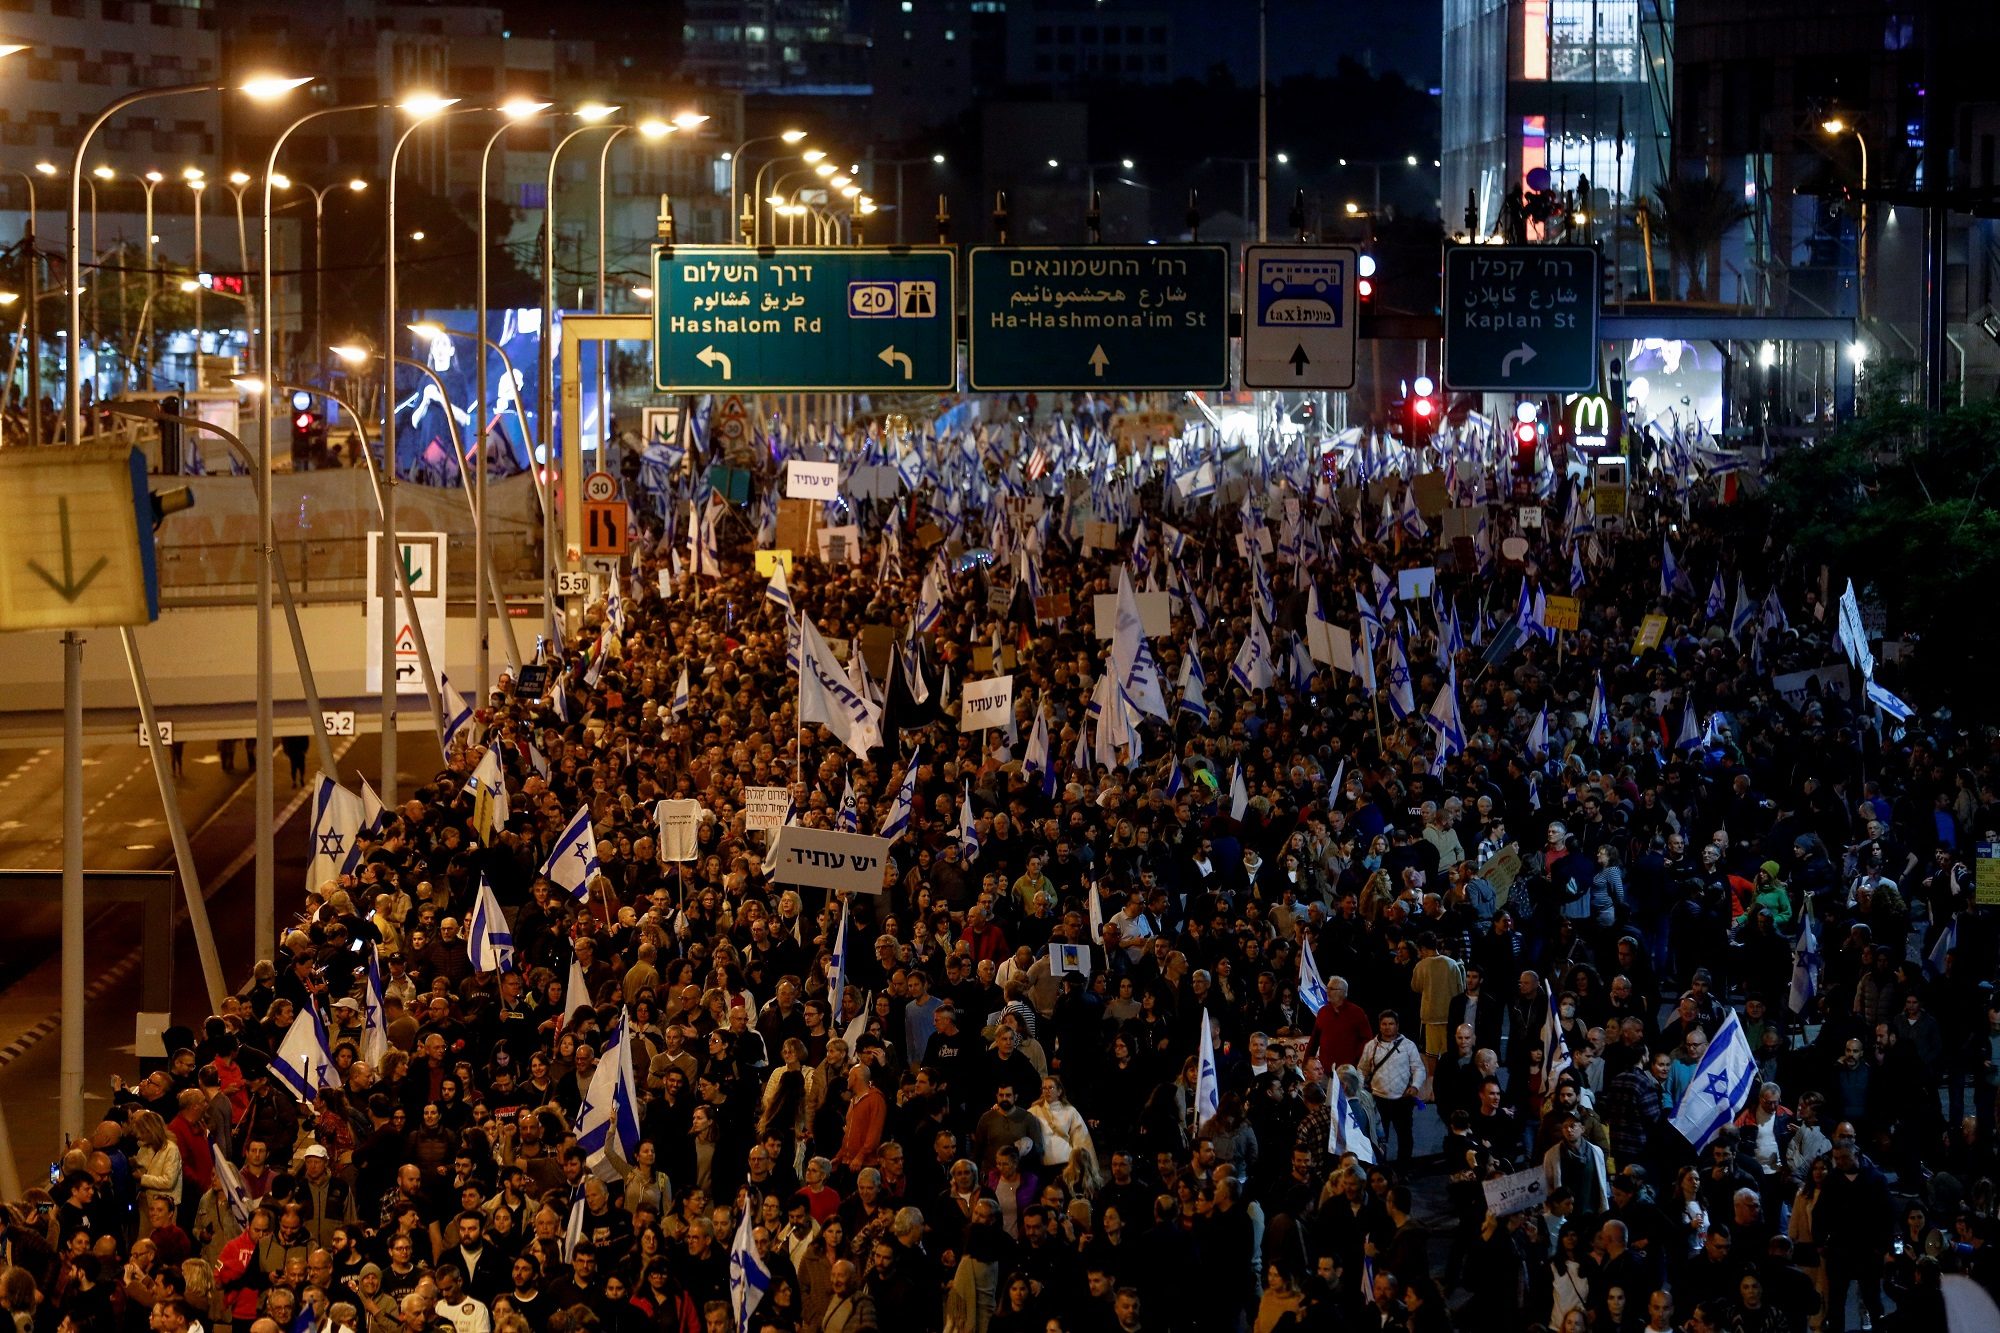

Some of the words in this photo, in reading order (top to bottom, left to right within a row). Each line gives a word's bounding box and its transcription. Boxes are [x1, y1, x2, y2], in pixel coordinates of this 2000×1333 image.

[683, 261, 758, 283] השלום
[770, 264, 813, 287] דרך
[1009, 259, 1140, 277] החשמונאים
[1470, 256, 1525, 280] קפלן
[760, 291, 805, 312] طريق
[861, 292, 886, 308] 20
[1139, 285, 1187, 307] شارع
[1530, 286, 1577, 309] شارع
[991, 311, 1173, 328] Ha-Hashmona'im
[1185, 311, 1206, 327] St
[1270, 306, 1302, 321] taxi
[1303, 309, 1332, 321] מונית
[1465, 312, 1542, 331] Kaplan
[1554, 312, 1576, 328] St
[670, 317, 780, 333] Hashalom
[794, 317, 822, 333] Rd
[592, 482, 609, 495] 30
[820, 477, 834, 487] יש
[559, 574, 589, 591] 5.50
[994, 694, 1007, 708] יש
[325, 716, 351, 730] 5.2
[850, 855, 877, 872] יש
